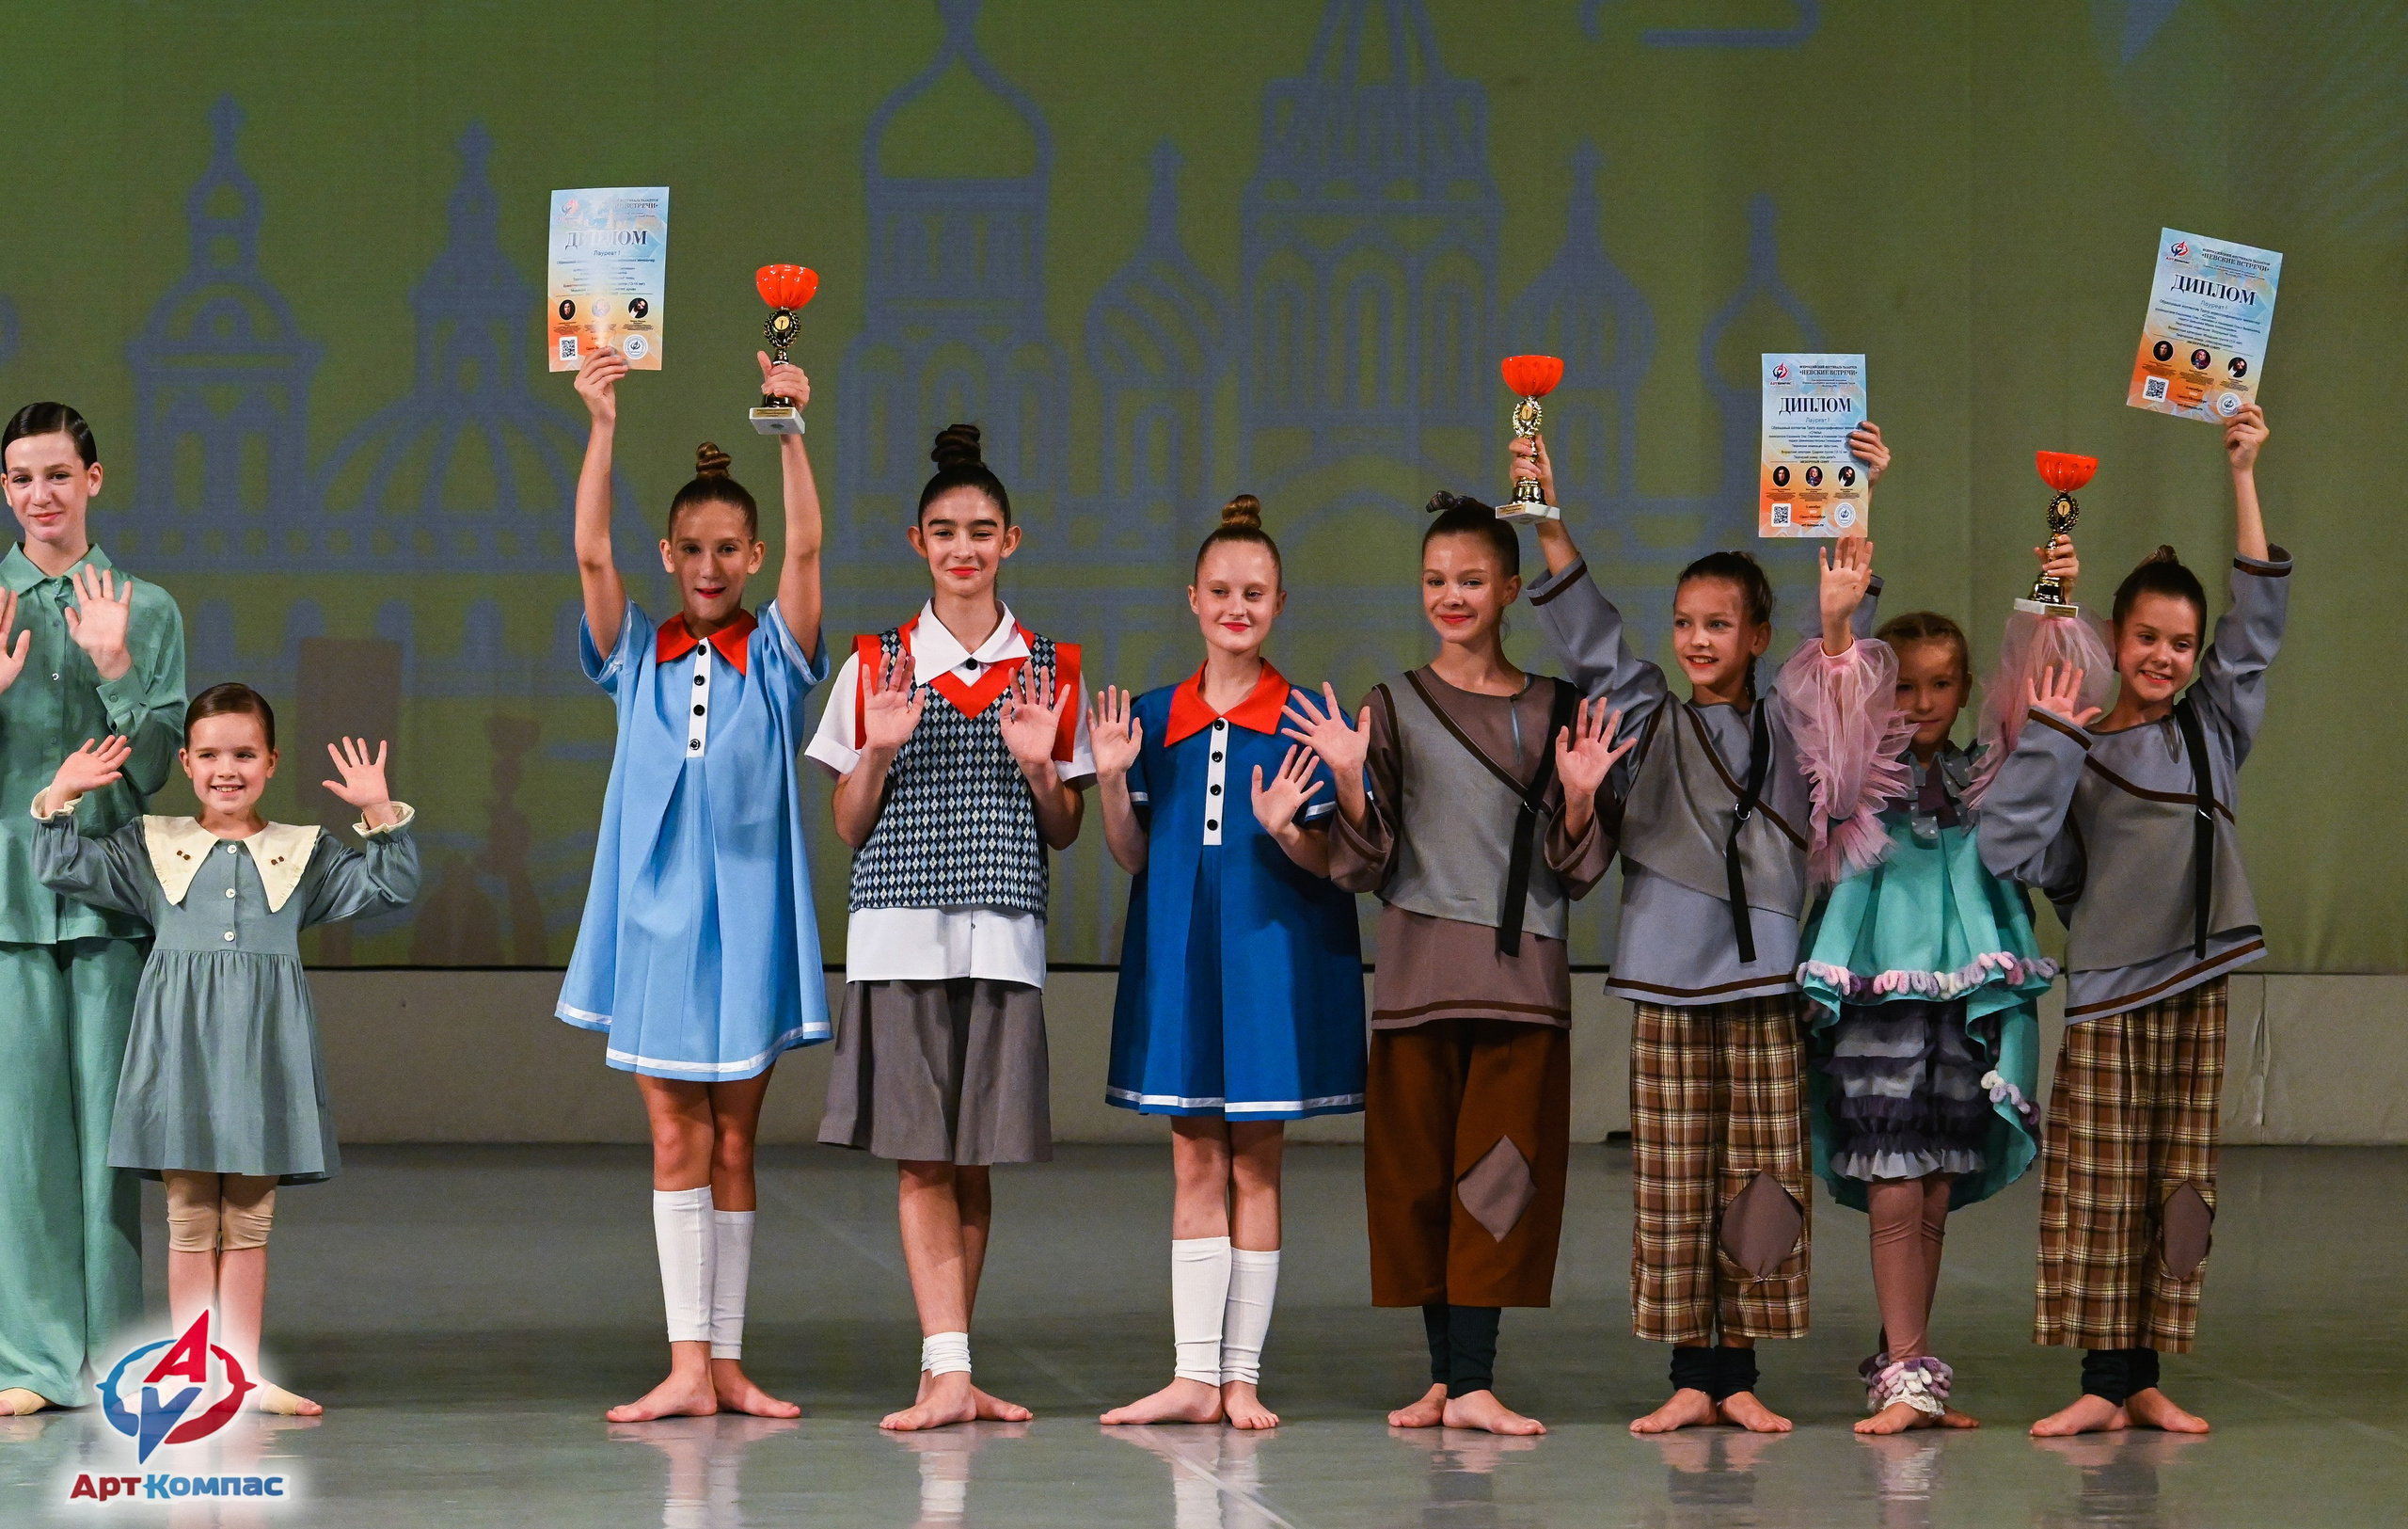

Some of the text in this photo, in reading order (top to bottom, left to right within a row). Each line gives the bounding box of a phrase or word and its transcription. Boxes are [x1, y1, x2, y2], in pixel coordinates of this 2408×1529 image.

[2170, 274, 2257, 306] ДИПЛОМ
[2201, 299, 2226, 311] Лауреат
[1778, 397, 1852, 416] ДИПЛОМ
